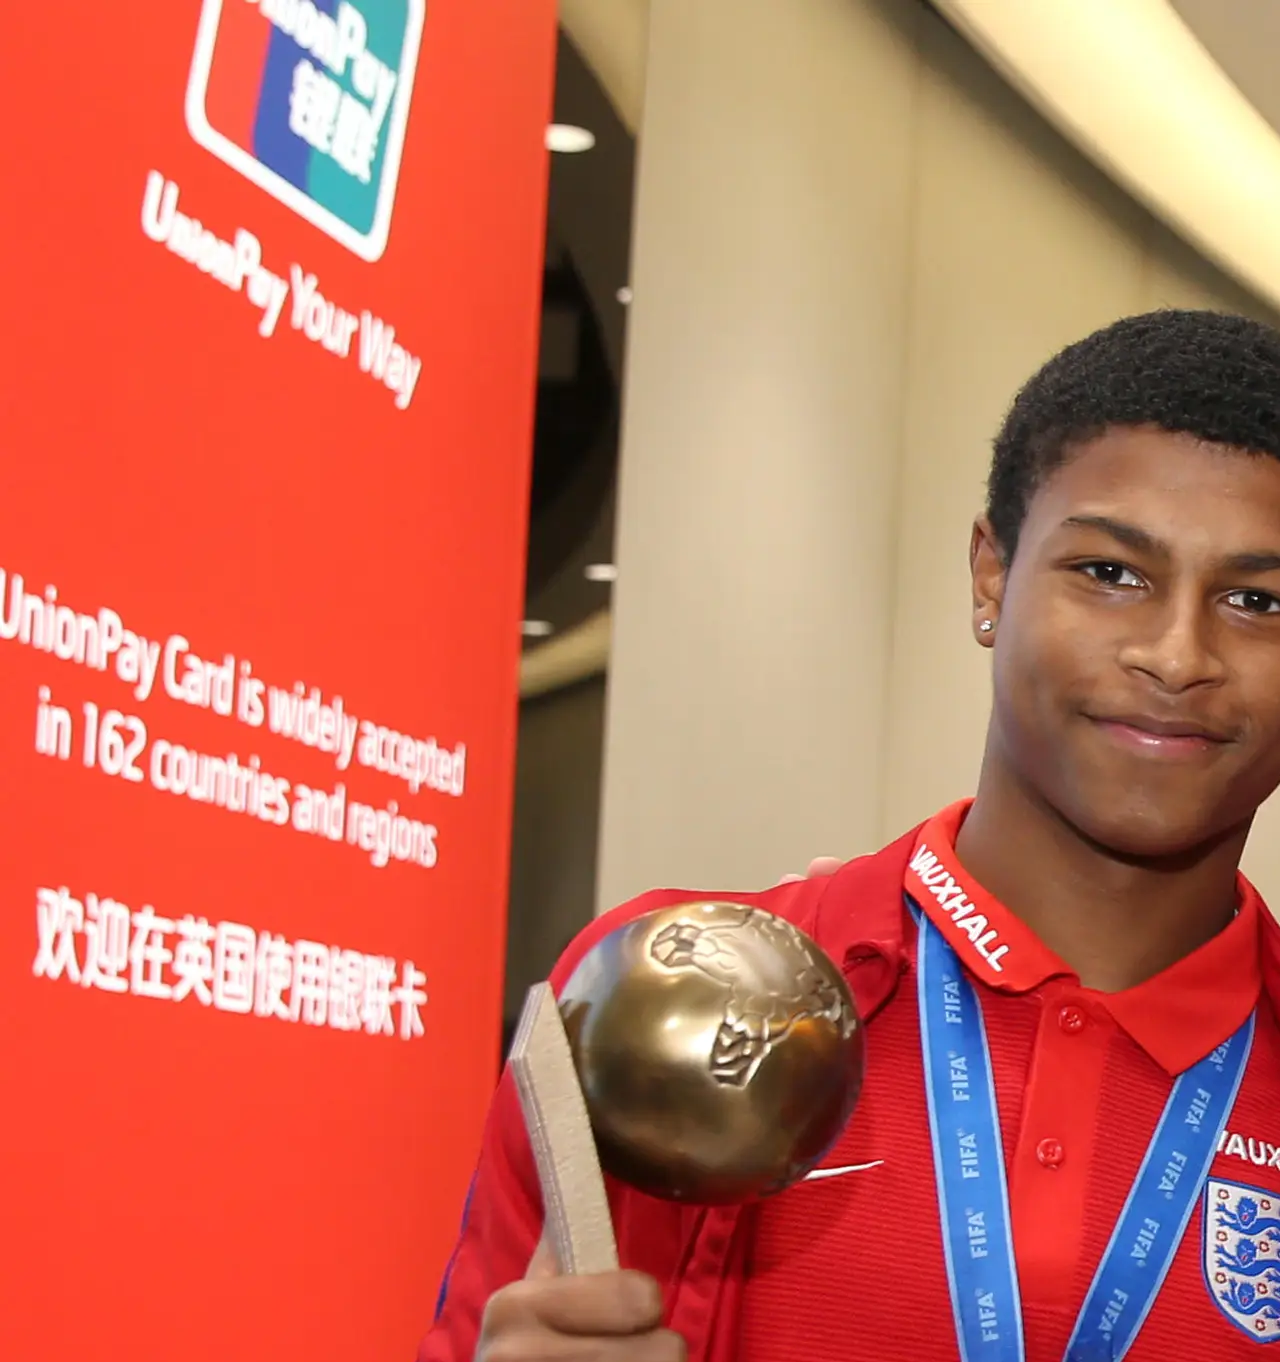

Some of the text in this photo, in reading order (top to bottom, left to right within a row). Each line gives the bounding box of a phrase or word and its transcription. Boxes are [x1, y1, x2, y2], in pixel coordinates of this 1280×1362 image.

[140, 169, 421, 409] UnionPay Your Way
[0, 568, 467, 796] UnionPay Card is widely accepted
[35, 686, 438, 868] in 162 countries and regions
[32, 886, 428, 1040] 欢迎在英国使用银联卡
[909, 844, 1010, 973] VAUXHALL
